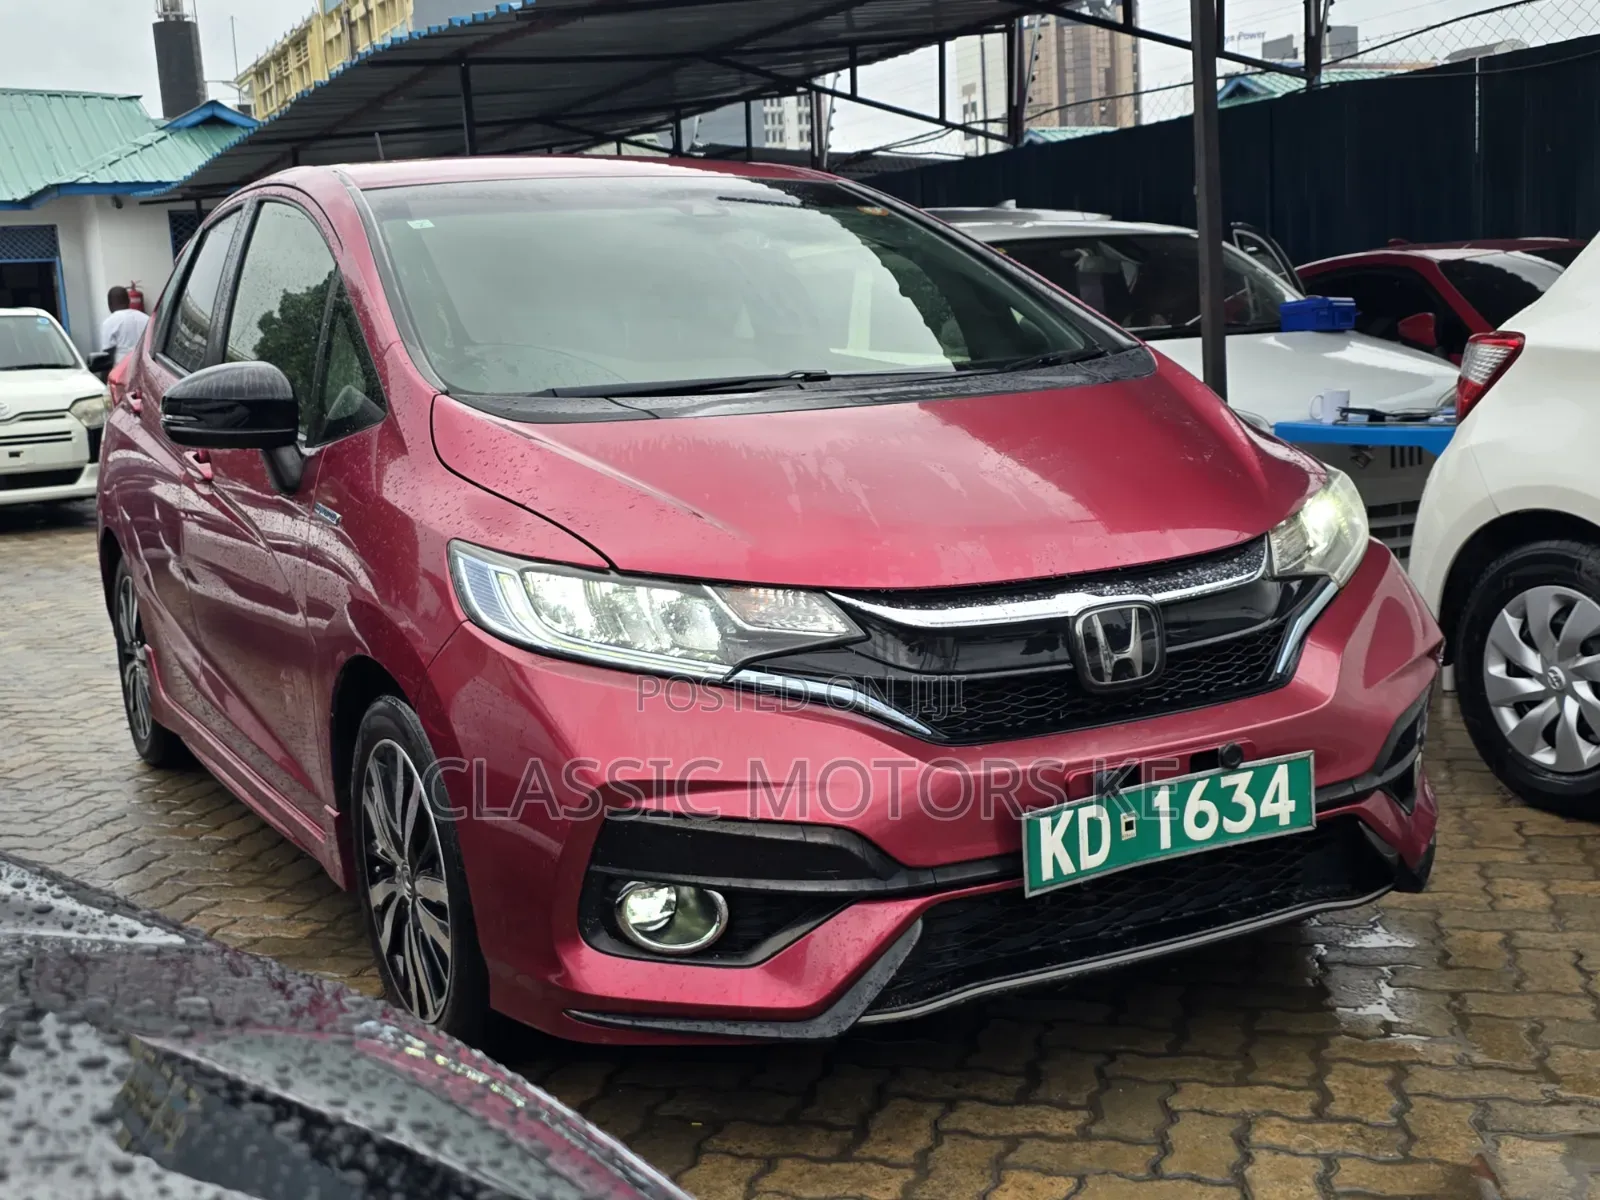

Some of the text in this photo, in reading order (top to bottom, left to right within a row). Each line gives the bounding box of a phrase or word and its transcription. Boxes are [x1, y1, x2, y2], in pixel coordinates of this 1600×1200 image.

[1237, 31, 1266, 41] Power
[1039, 763, 1296, 882] KD 1634
